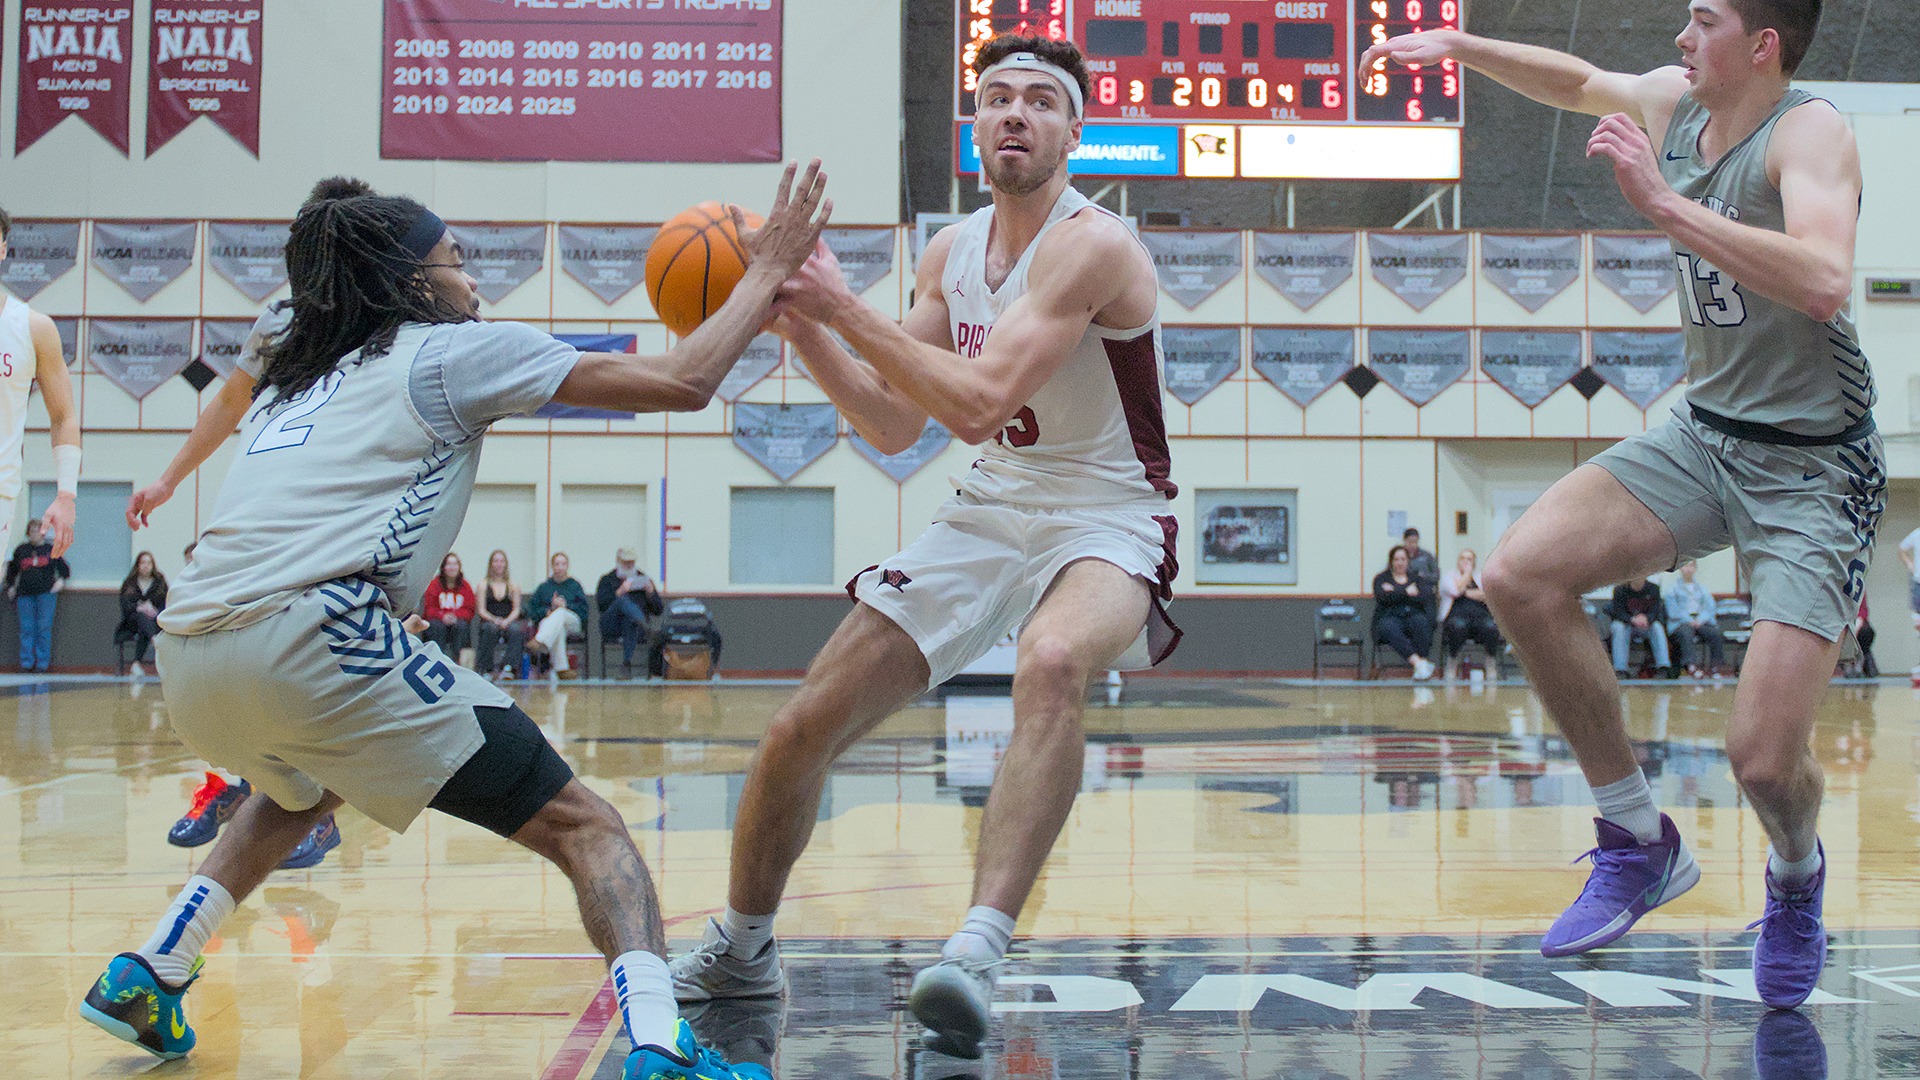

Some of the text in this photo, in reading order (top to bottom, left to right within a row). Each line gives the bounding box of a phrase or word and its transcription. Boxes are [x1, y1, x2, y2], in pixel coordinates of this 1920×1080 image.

[25, 8, 131, 22] RUNNER-UP
[155, 9, 260, 23] RUNNER-UP
[1095, 0, 1142, 17] HOME
[1190, 13, 1230, 25] PERIOD
[1275, 2, 1328, 19] GUEST
[1371, 0, 1458, 22] 4 0 0
[970, 18, 993, 40] 15
[27, 25, 123, 63] NAIA
[157, 26, 253, 65] NAIA
[394, 39, 772, 62] 2005 2008 2009 2010 2011 2012
[393, 67, 772, 89] 2013 2014 2015 2016 2017 2018
[1086, 61, 1117, 73] OULS
[1162, 61, 1185, 73] PLYR
[1198, 62, 1226, 74] FOUL
[1242, 62, 1259, 74] PTS
[1304, 63, 1341, 75] FOULS
[37, 77, 112, 92] SWIMMING
[159, 78, 250, 92] BASKETBALL
[1098, 75, 1119, 105] 8
[1129, 79, 1145, 103] 3
[1172, 77, 1193, 107] 2
[1201, 77, 1221, 107] 0
[1248, 78, 1268, 108] 0
[1277, 83, 1293, 103] 4
[1321, 78, 1342, 108] 6
[1412, 76, 1424, 95] 1
[1442, 74, 1458, 97] 3
[392, 94, 576, 115] 2019 2024 2025
[1405, 98, 1424, 121] 6
[1676, 251, 1747, 327] 13
[246, 369, 346, 456] 2
[402, 653, 456, 704] G
